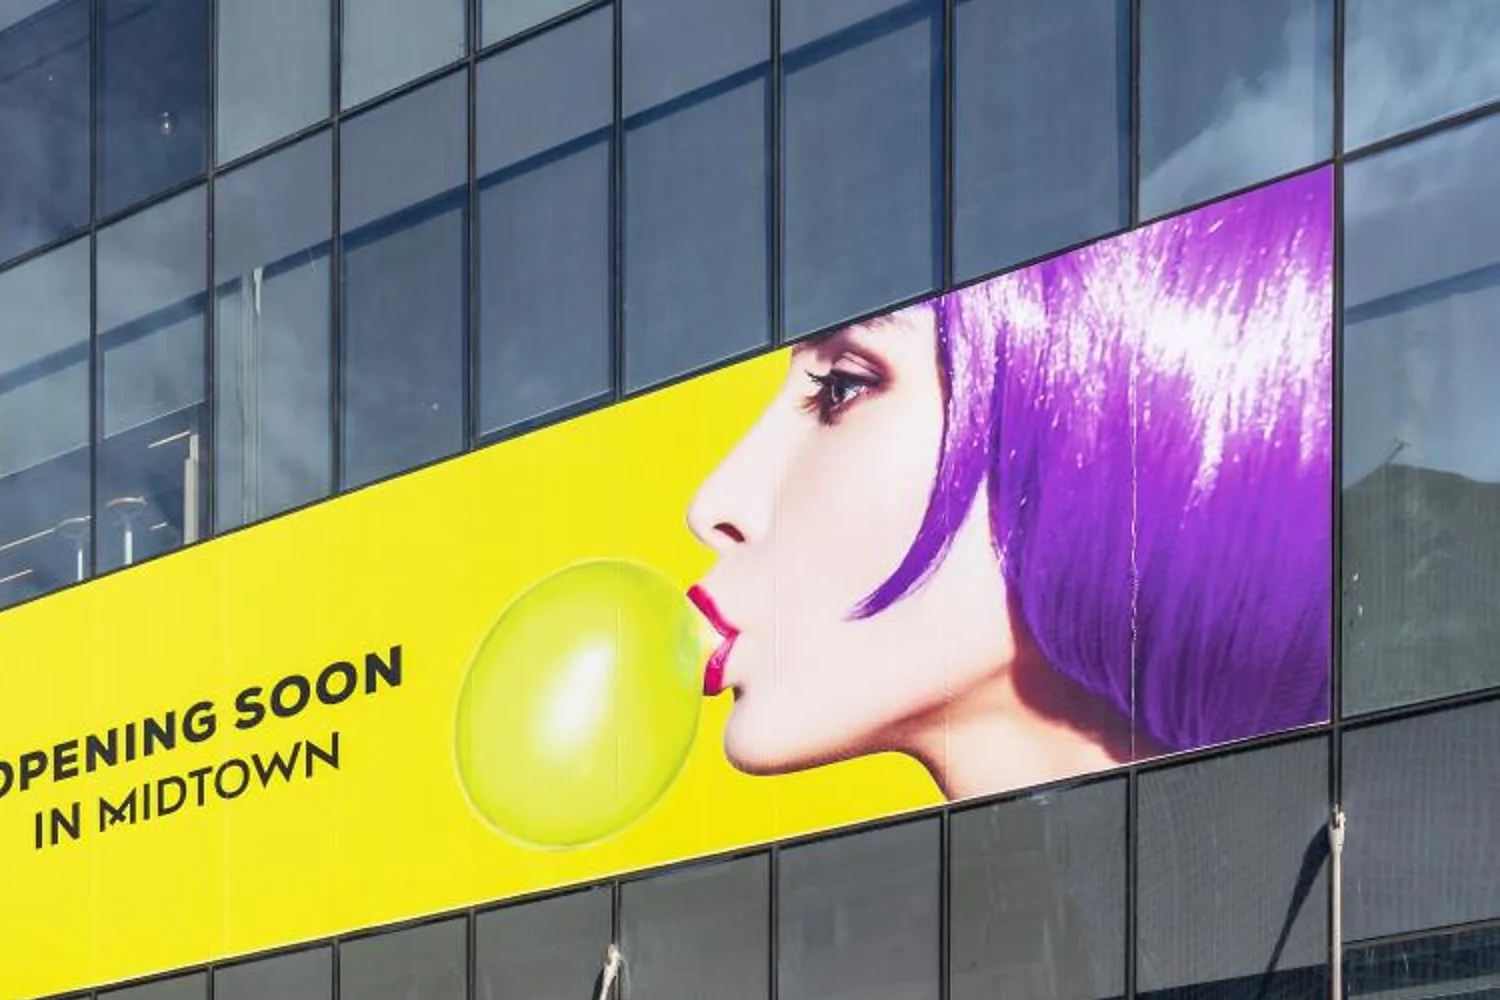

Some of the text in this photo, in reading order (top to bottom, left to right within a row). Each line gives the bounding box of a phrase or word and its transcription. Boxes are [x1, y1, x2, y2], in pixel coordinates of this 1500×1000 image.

[235, 645, 402, 730] SOON
[35, 731, 339, 849] IN MIDTOWN
